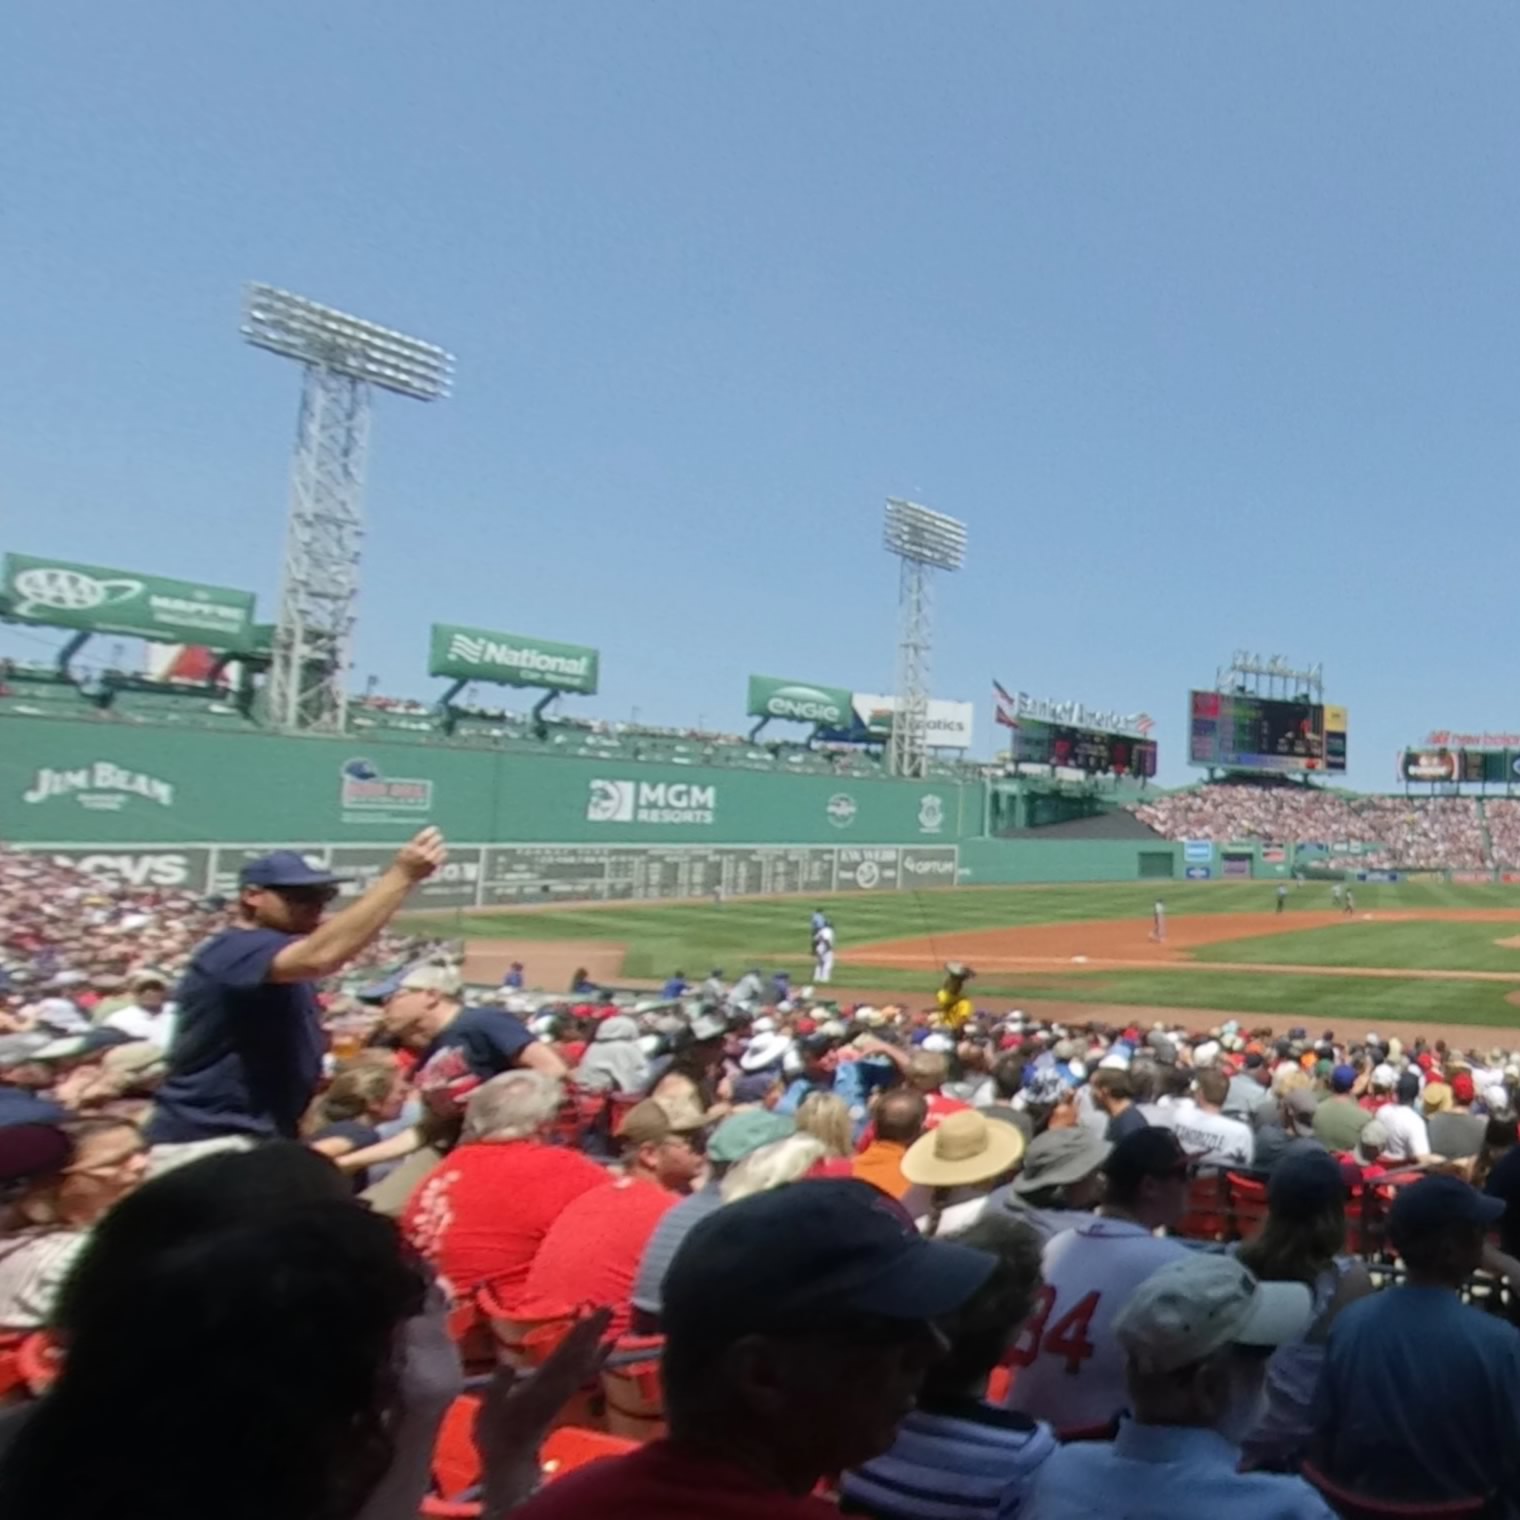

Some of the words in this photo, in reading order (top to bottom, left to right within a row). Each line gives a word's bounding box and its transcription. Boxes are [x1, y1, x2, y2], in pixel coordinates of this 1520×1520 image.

[484, 641, 588, 675] National
[639, 781, 715, 808] MGM
[637, 808, 714, 824] RESORTS
[915, 861, 954, 875] OPTUM
